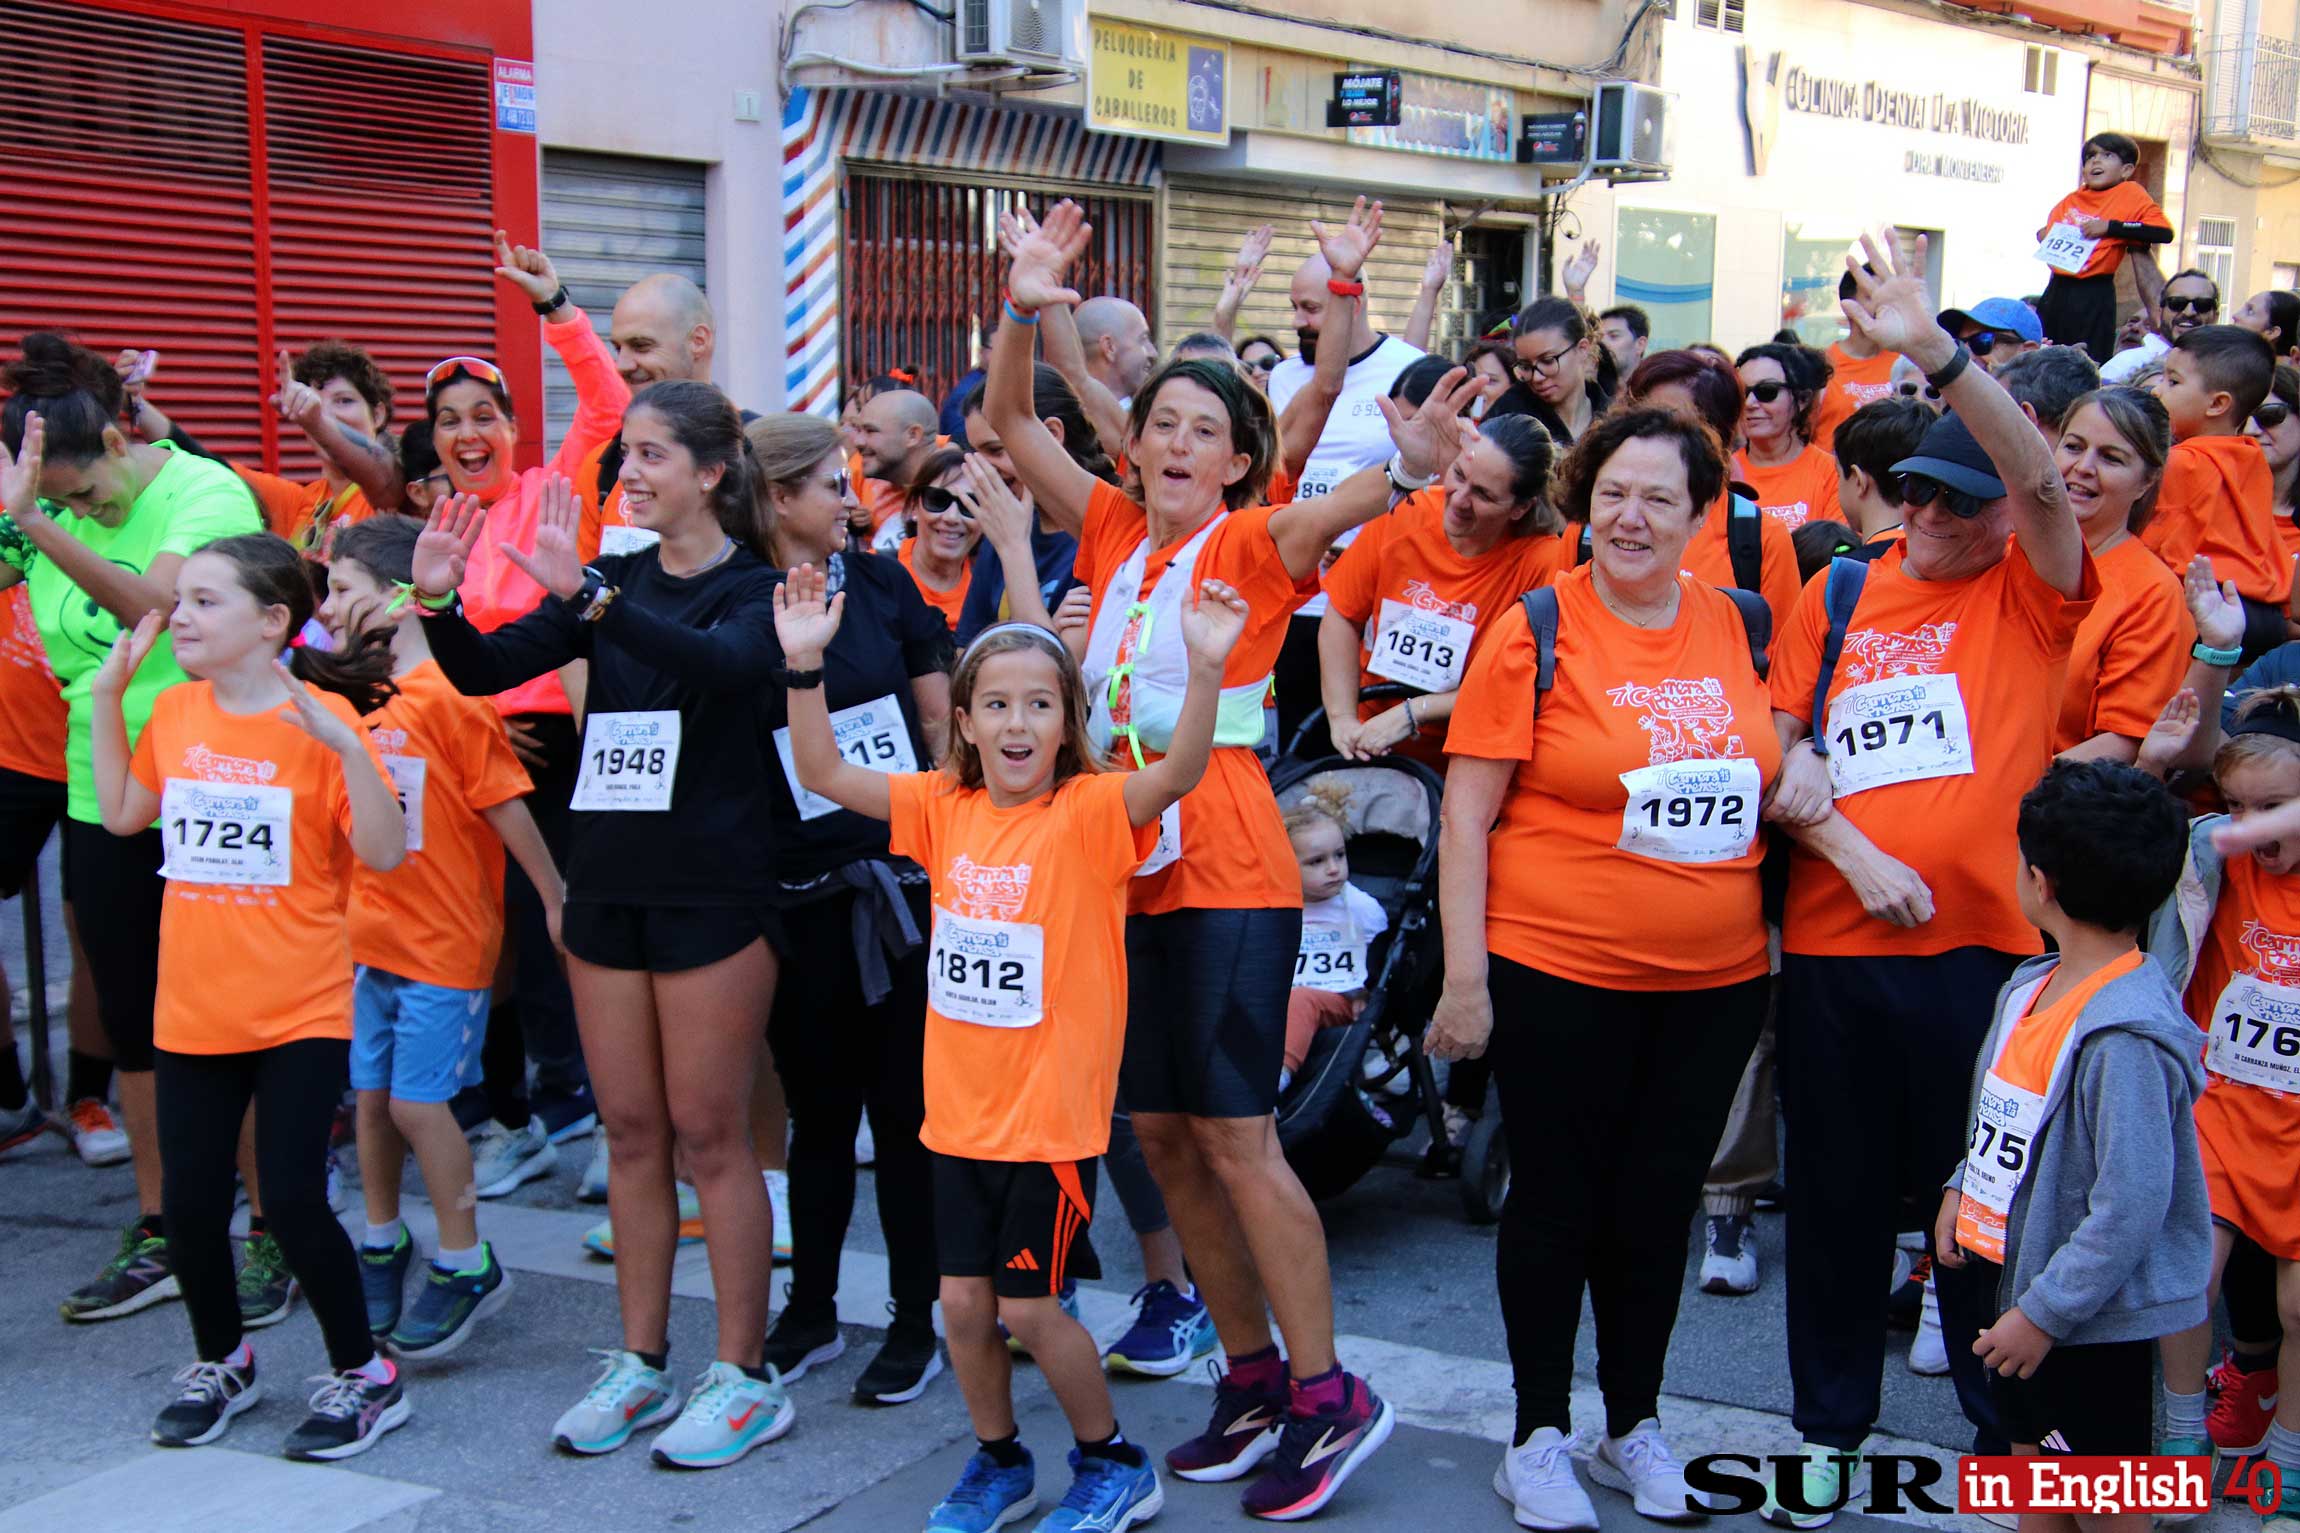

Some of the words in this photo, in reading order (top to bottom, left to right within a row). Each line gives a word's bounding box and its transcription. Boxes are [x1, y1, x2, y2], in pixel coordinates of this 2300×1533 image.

[1094, 28, 1176, 63] PELUQUERIA
[496, 65, 533, 82] ALARMA
[1127, 67, 1144, 91] DE
[1094, 95, 1177, 128] CABALLEROS
[1962, 97, 2030, 145] VICTORIA
[2047, 237, 2085, 258] 1872
[1388, 629, 1454, 668] 1813
[838, 732, 896, 765] 15
[1836, 710, 1946, 757] 1971
[593, 748, 665, 775] 1948
[1641, 795, 1744, 827] 1972
[172, 818, 273, 850] 1724
[936, 948, 1024, 991] 1812
[1296, 951, 1354, 975] 734
[2225, 1012, 2300, 1057] 176
